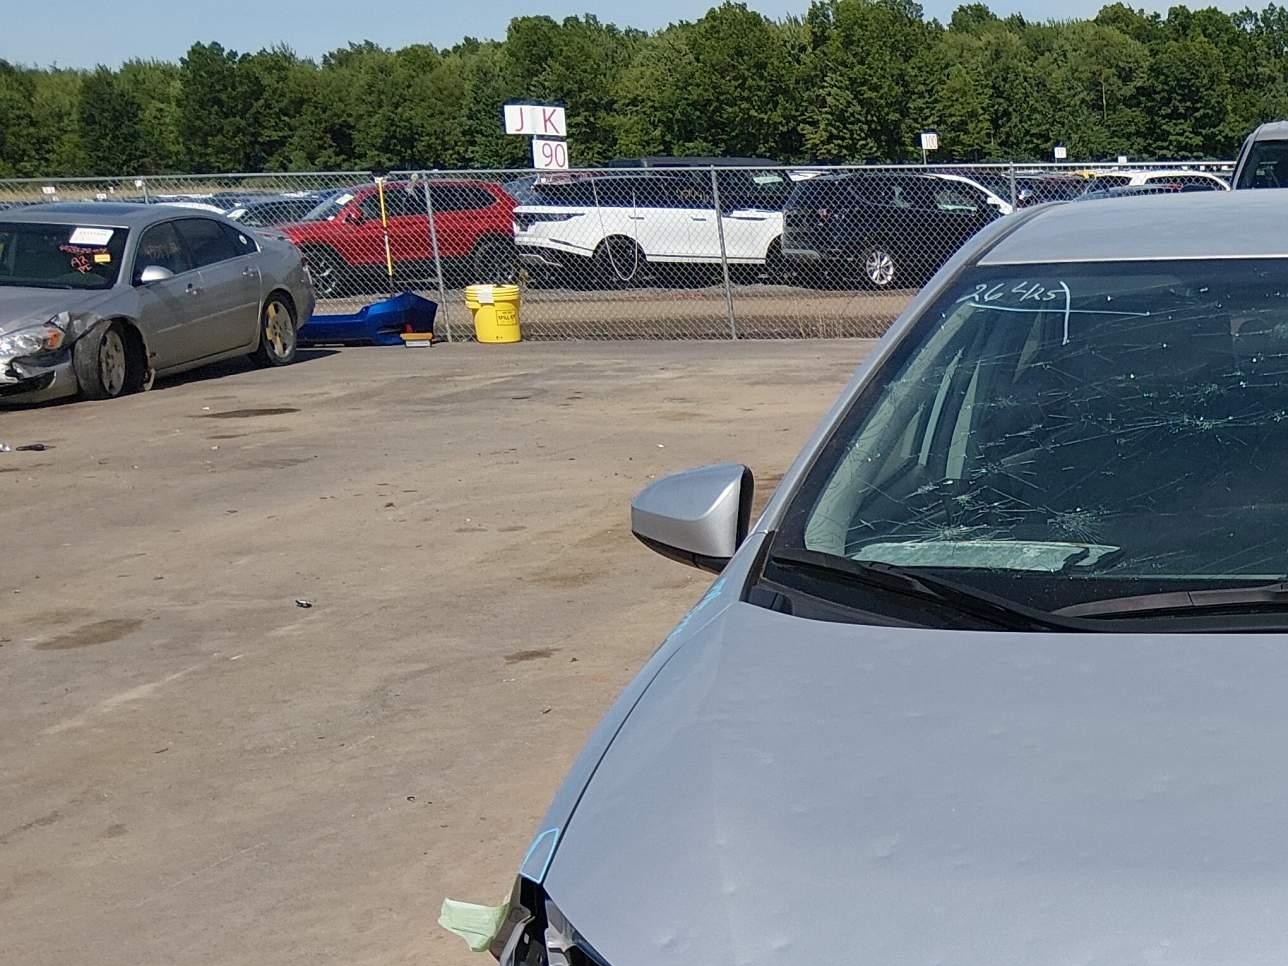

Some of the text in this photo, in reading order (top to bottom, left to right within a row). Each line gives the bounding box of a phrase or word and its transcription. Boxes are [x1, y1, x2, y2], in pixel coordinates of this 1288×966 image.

[515, 107, 560, 134] J K
[542, 142, 566, 168] 90
